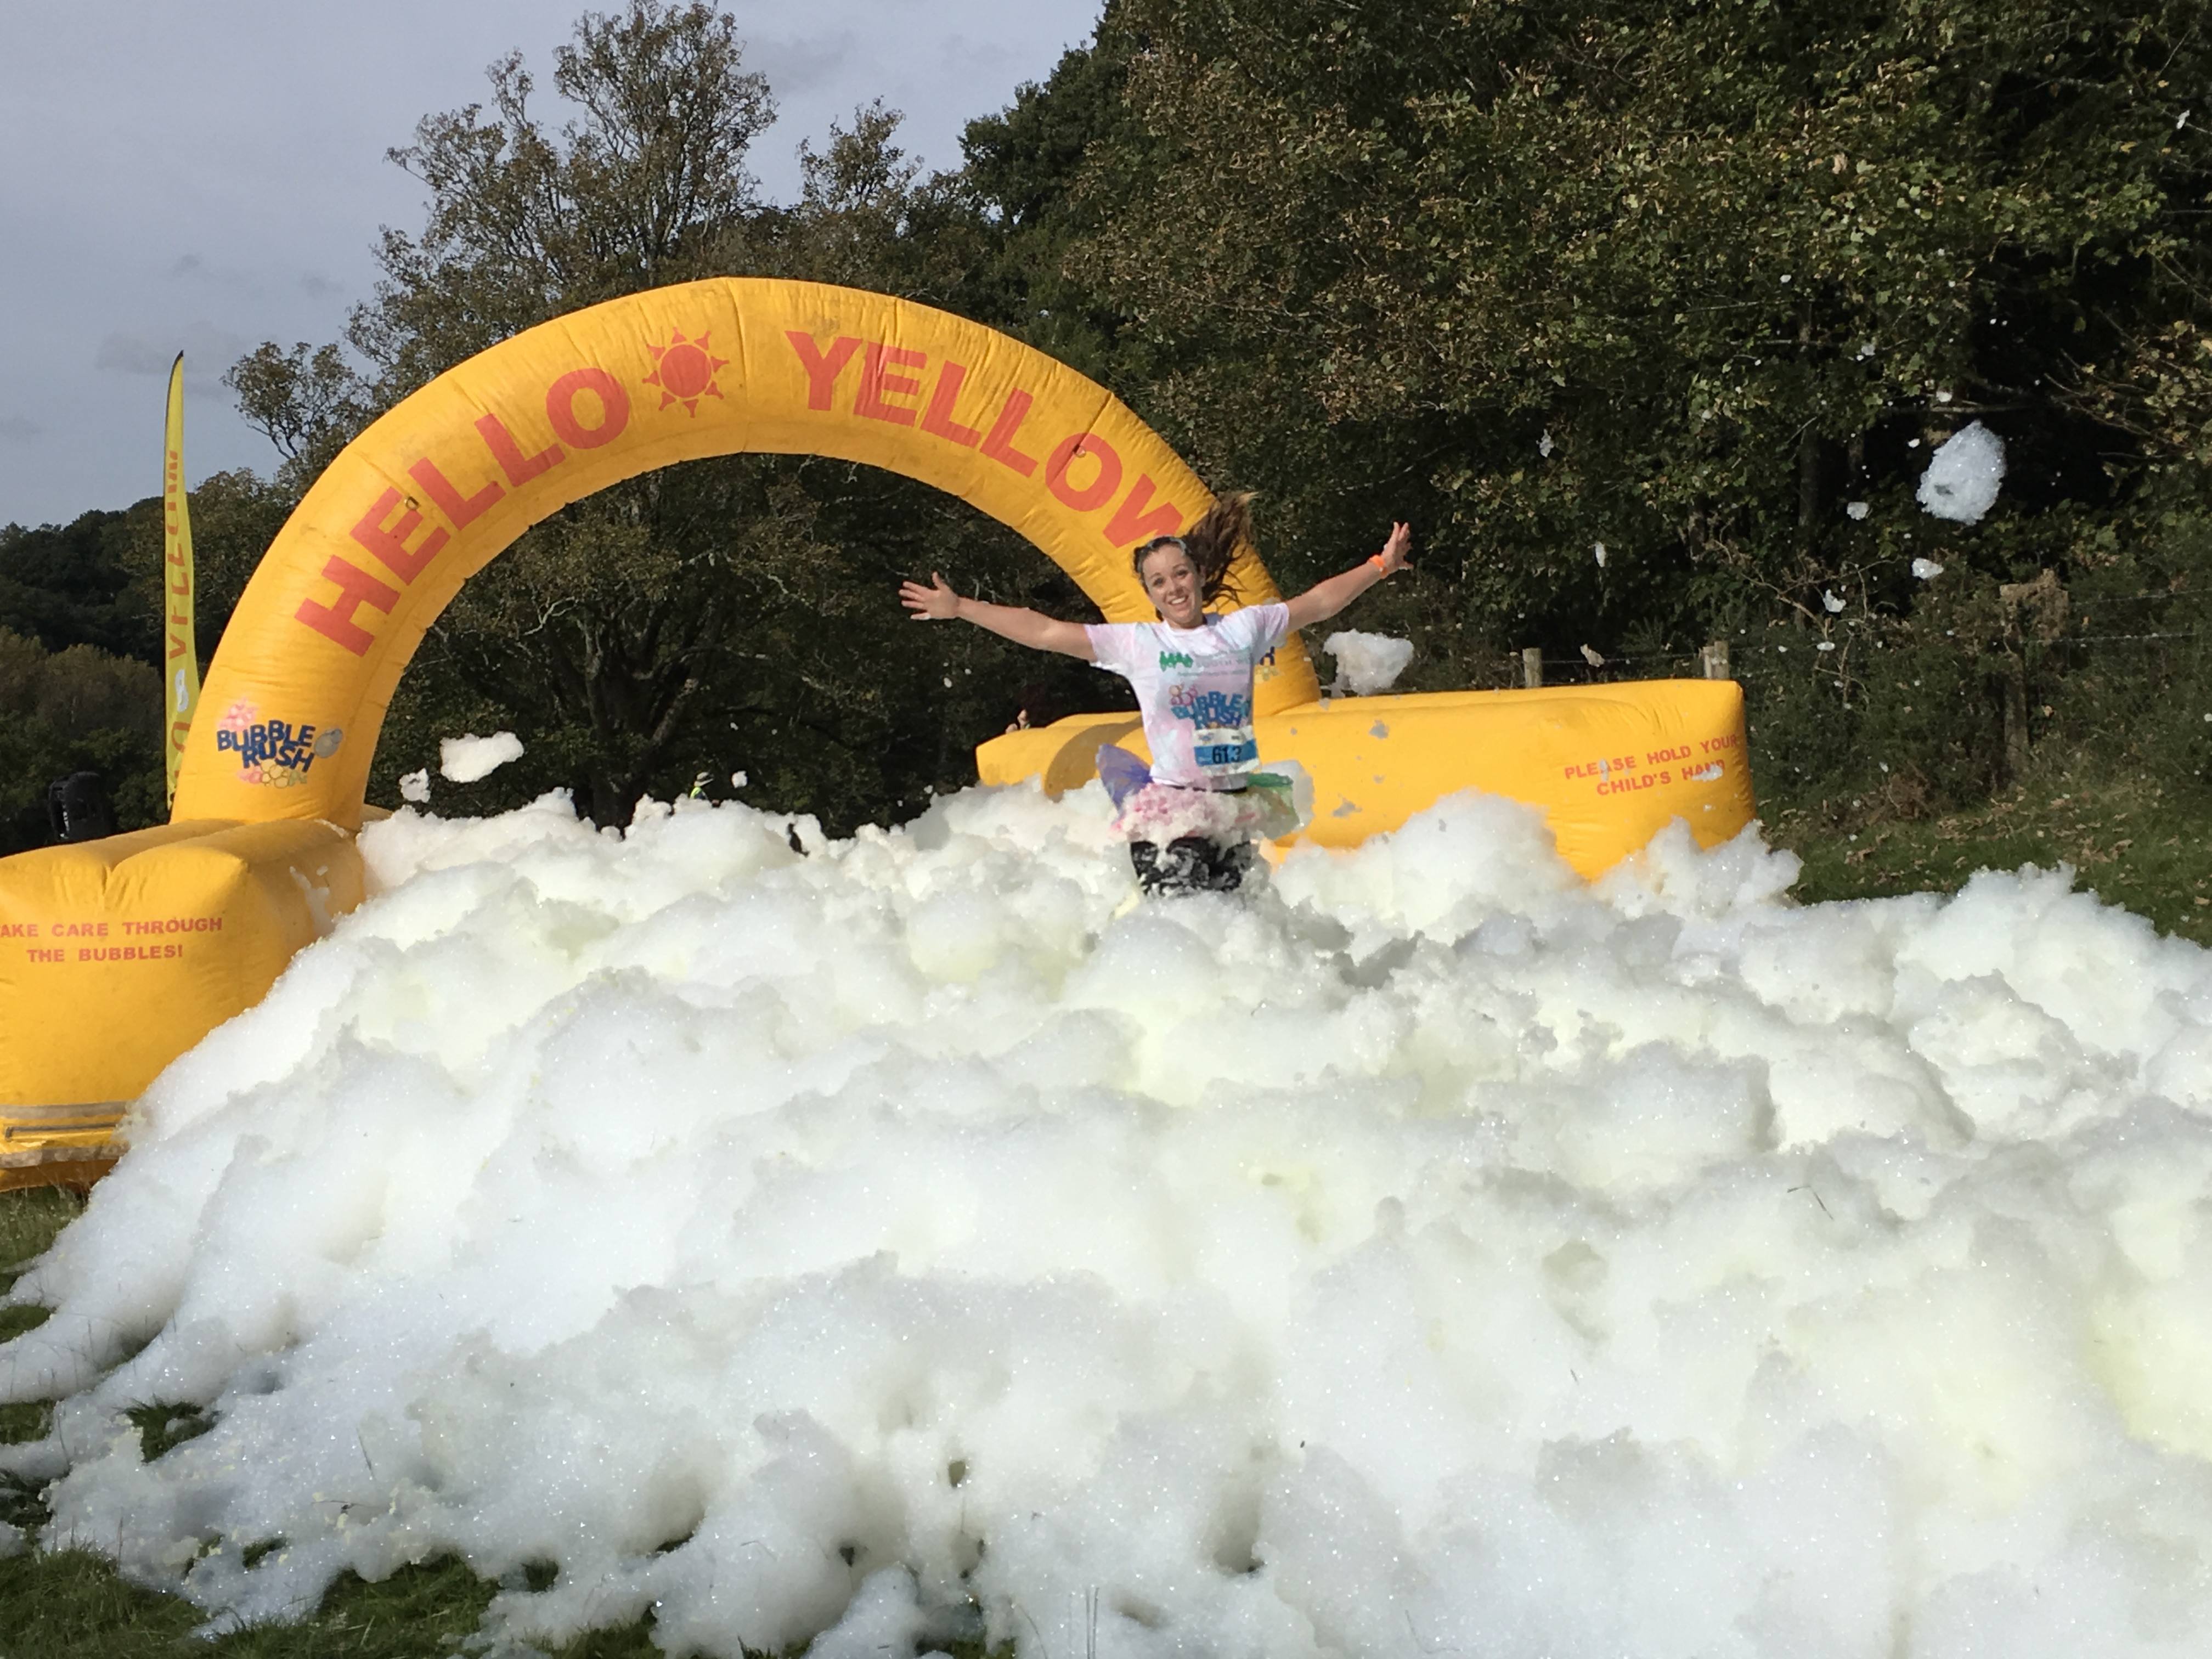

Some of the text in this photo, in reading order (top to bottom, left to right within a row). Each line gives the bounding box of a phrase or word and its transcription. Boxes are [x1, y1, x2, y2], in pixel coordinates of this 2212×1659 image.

[294, 331, 1184, 657] HELLO YELLOW
[1171, 691, 1243, 719] BUBBLE
[217, 720, 316, 752] BUBBLE
[241, 741, 314, 772] RUSH
[1212, 746, 1242, 764] 613
[1564, 734, 1738, 780] PLEASE HOLD YOUR
[1596, 771, 1672, 795] CHILD'S
[0, 917, 223, 938] AKE CARE THROUGH
[26, 944, 183, 962] THE BUBBLES!
